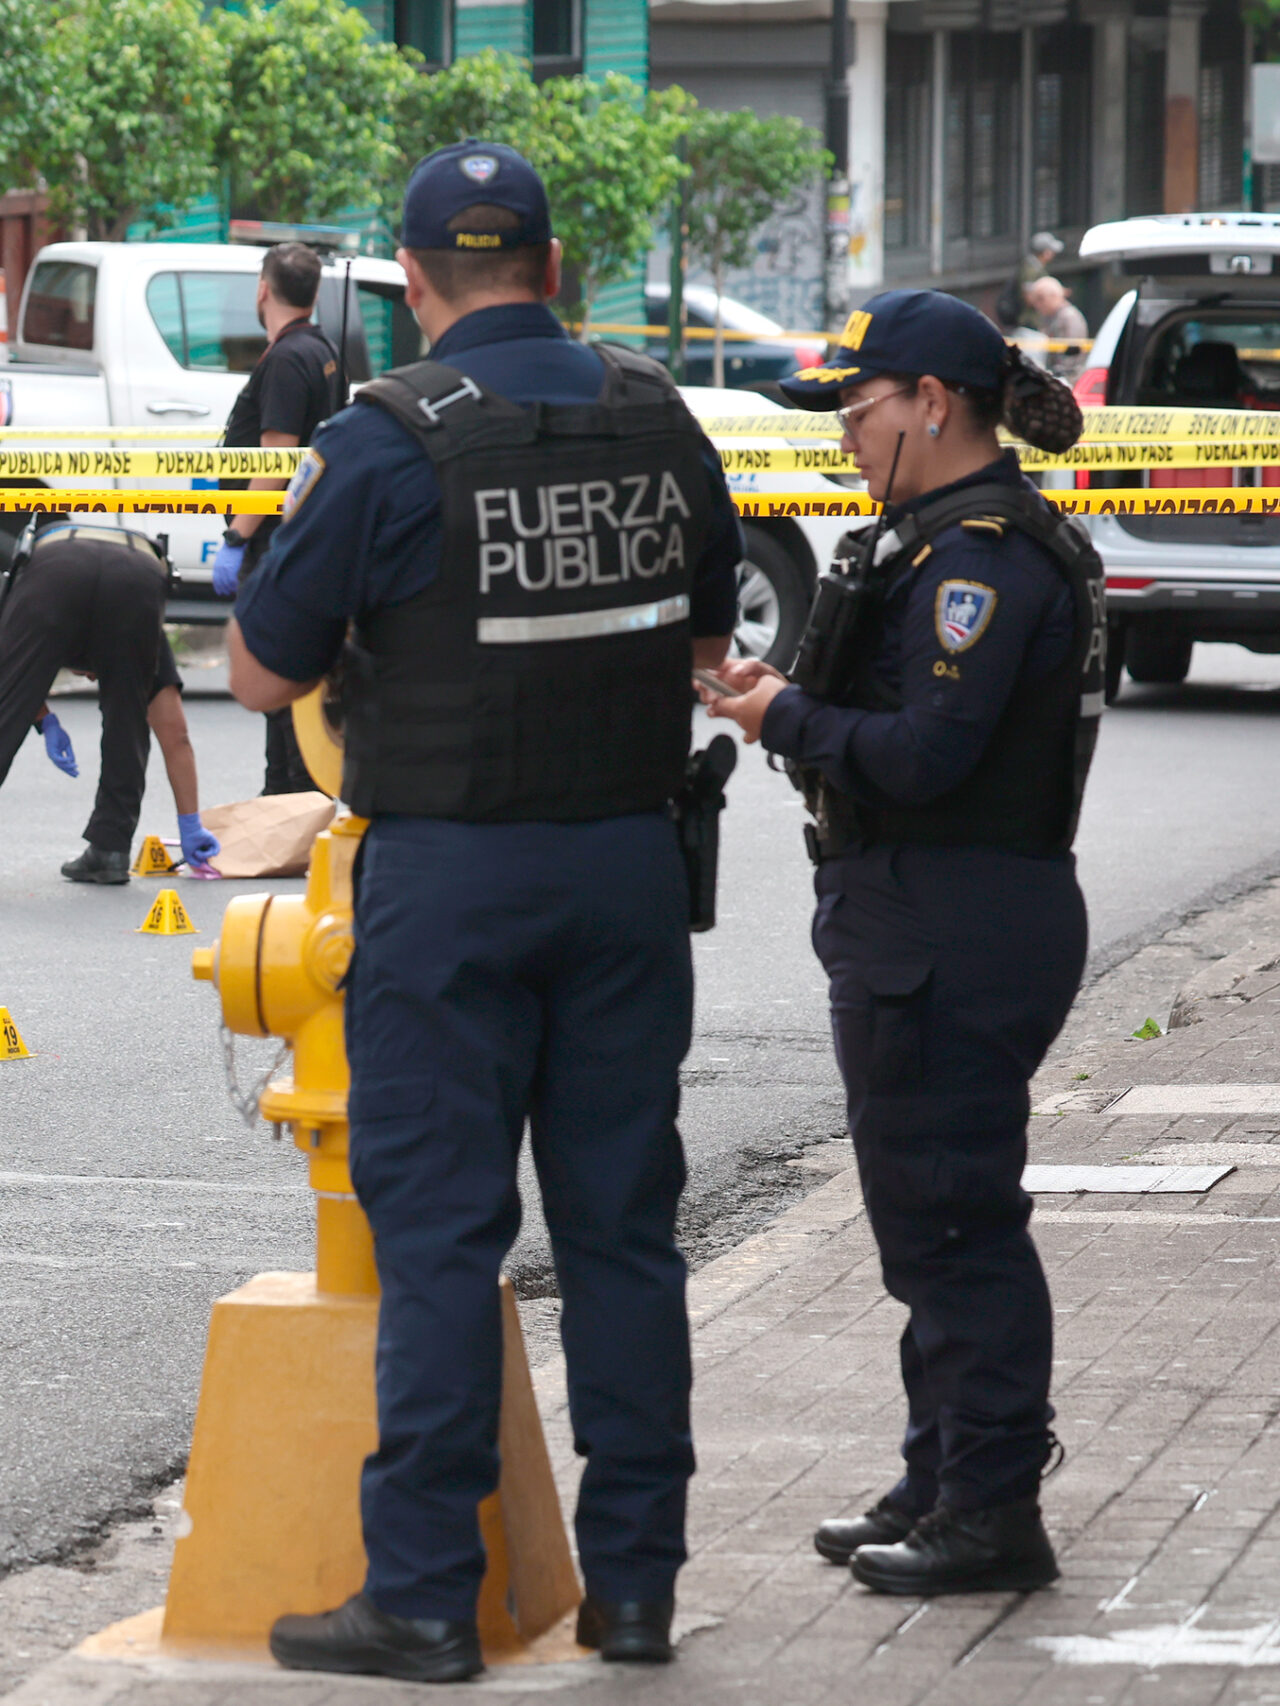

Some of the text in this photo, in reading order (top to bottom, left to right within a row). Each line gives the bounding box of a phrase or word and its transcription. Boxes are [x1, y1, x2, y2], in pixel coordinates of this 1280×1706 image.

[68, 451, 90, 474] NO
[94, 451, 132, 475] PASE
[156, 450, 214, 474] FUERZA
[219, 450, 283, 474] PUBLICA
[1054, 445, 1112, 464] UBLICA
[474, 471, 691, 541] FUERZA
[479, 523, 684, 594] PUBLICA
[4, 1025, 18, 1047] 19
